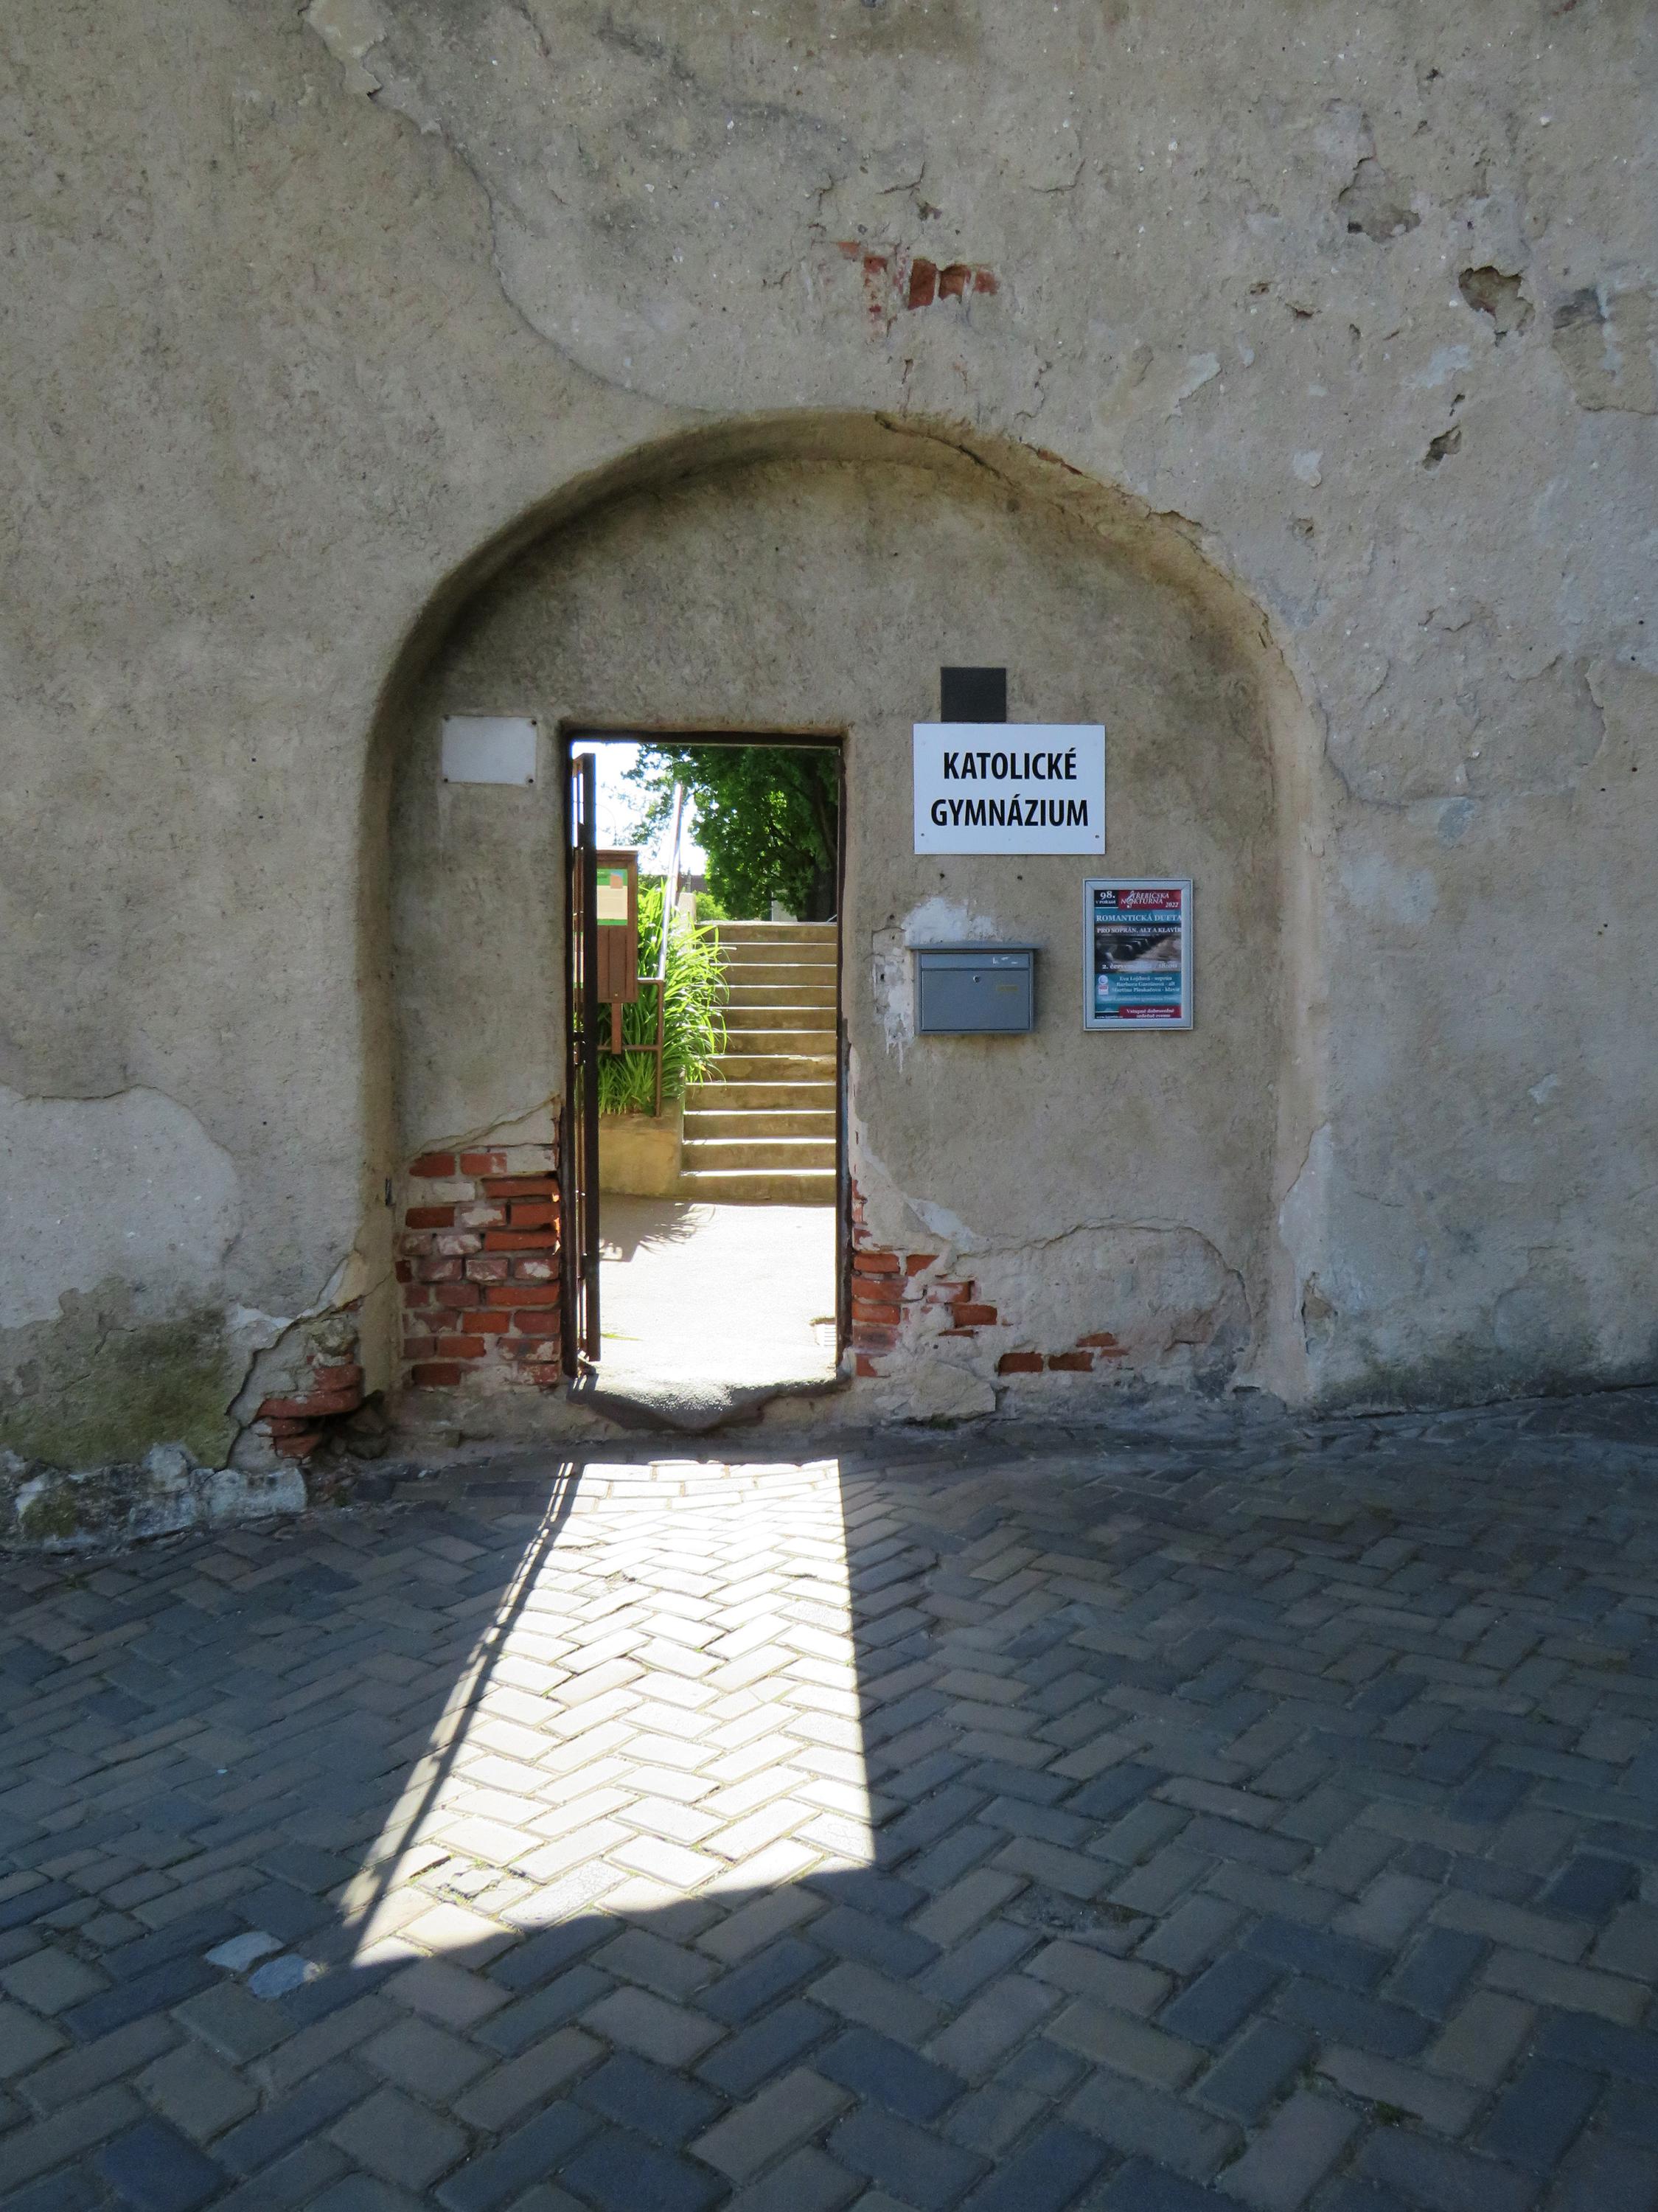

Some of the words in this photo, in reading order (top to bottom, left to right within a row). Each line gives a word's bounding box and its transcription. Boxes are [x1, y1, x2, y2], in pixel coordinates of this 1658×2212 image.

[944, 747, 1077, 780] KATOLICKÉ
[930, 793, 1089, 827] GYMNÁZIUM
[1100, 890, 1115, 900] 98.
[1096, 913, 1153, 922] ROMANTICKÁ
